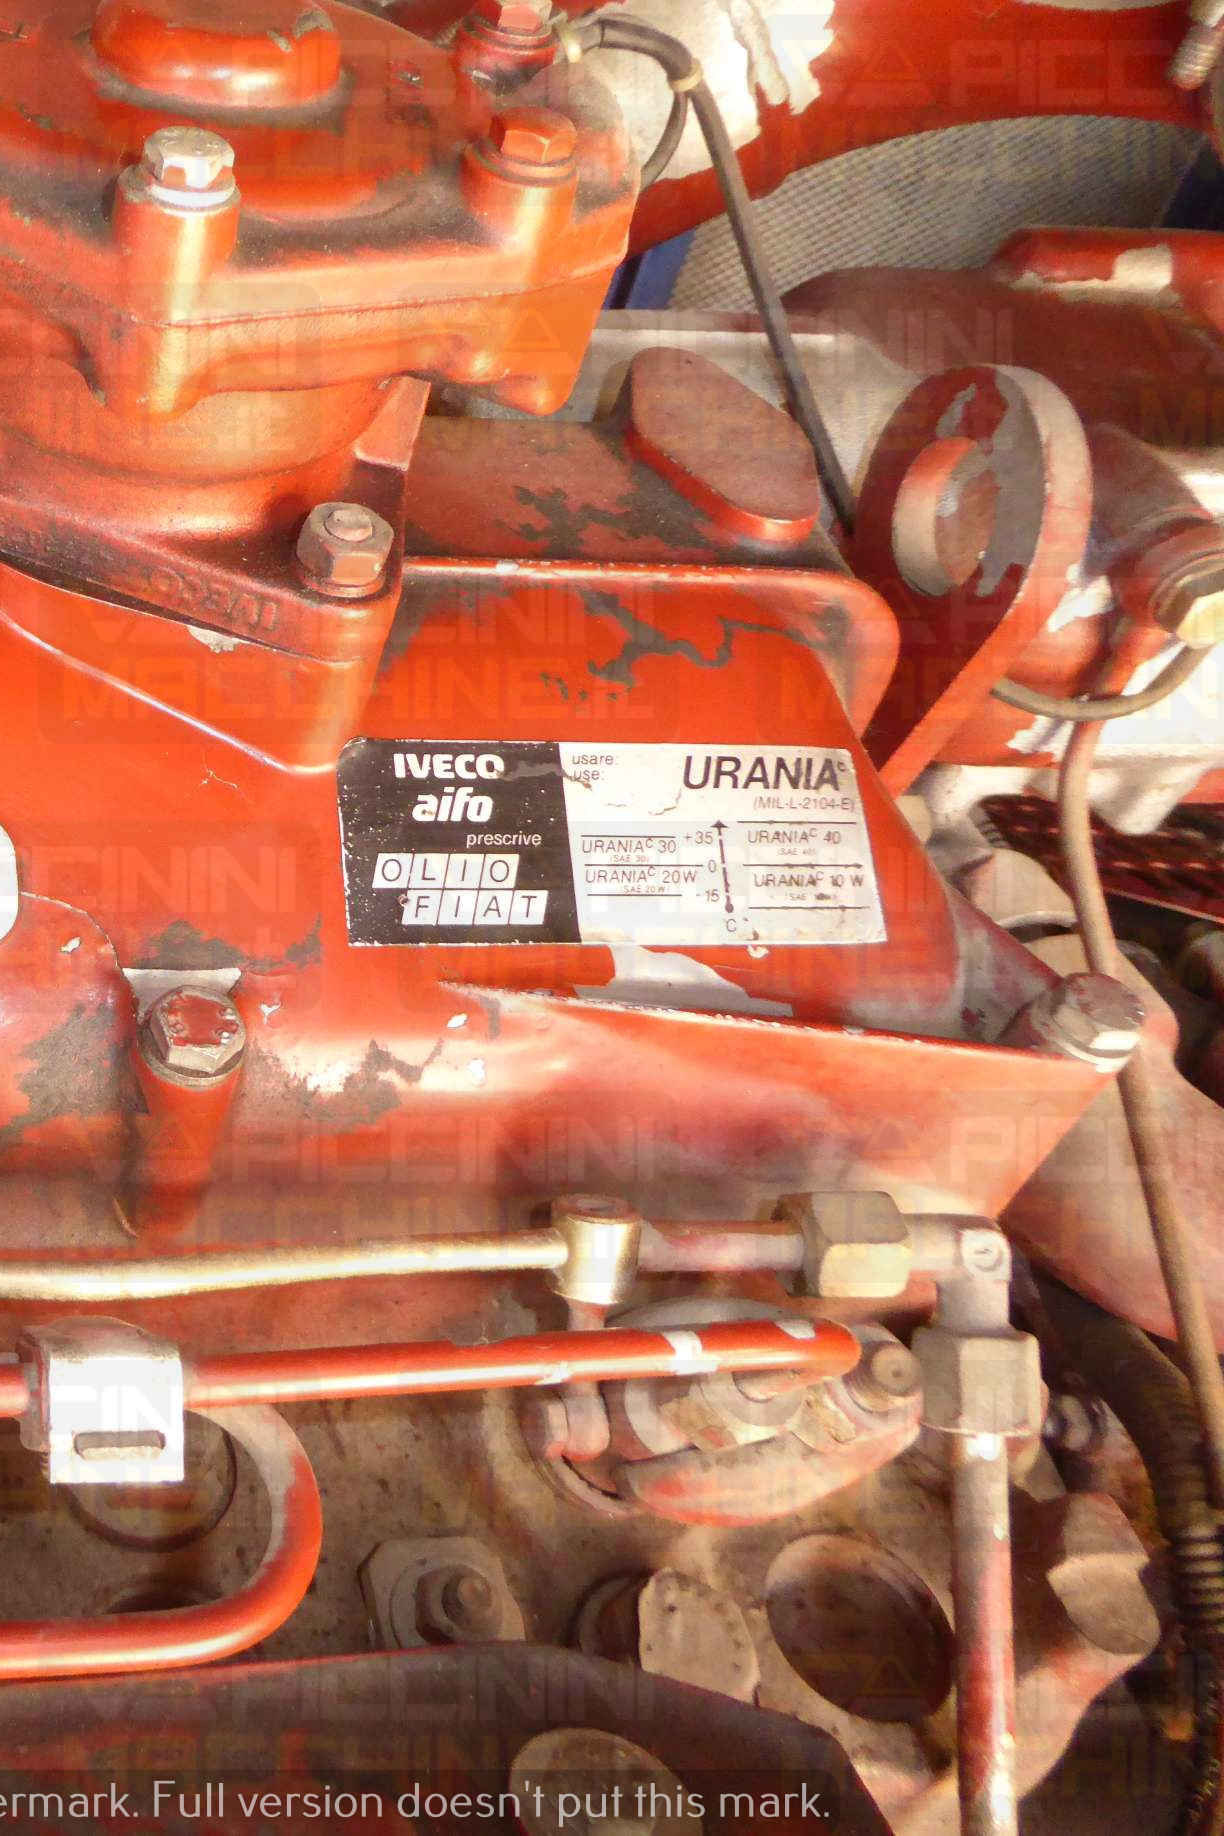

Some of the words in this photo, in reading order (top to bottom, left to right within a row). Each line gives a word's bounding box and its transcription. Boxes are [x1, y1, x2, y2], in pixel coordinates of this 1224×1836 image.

[393, 753, 504, 779] IVECO
[572, 754, 619, 765] usare:
[573, 769, 605, 781] use:
[412, 786, 494, 822] aifo
[753, 797, 856, 812] (MIL-L-2104-E)
[466, 832, 542, 848] prescrive
[824, 831, 841, 844] 40
[658, 839, 677, 853] 30
[382, 858, 510, 882] OLIO
[707, 859, 717, 873] 0
[415, 895, 537, 918] FIAT
